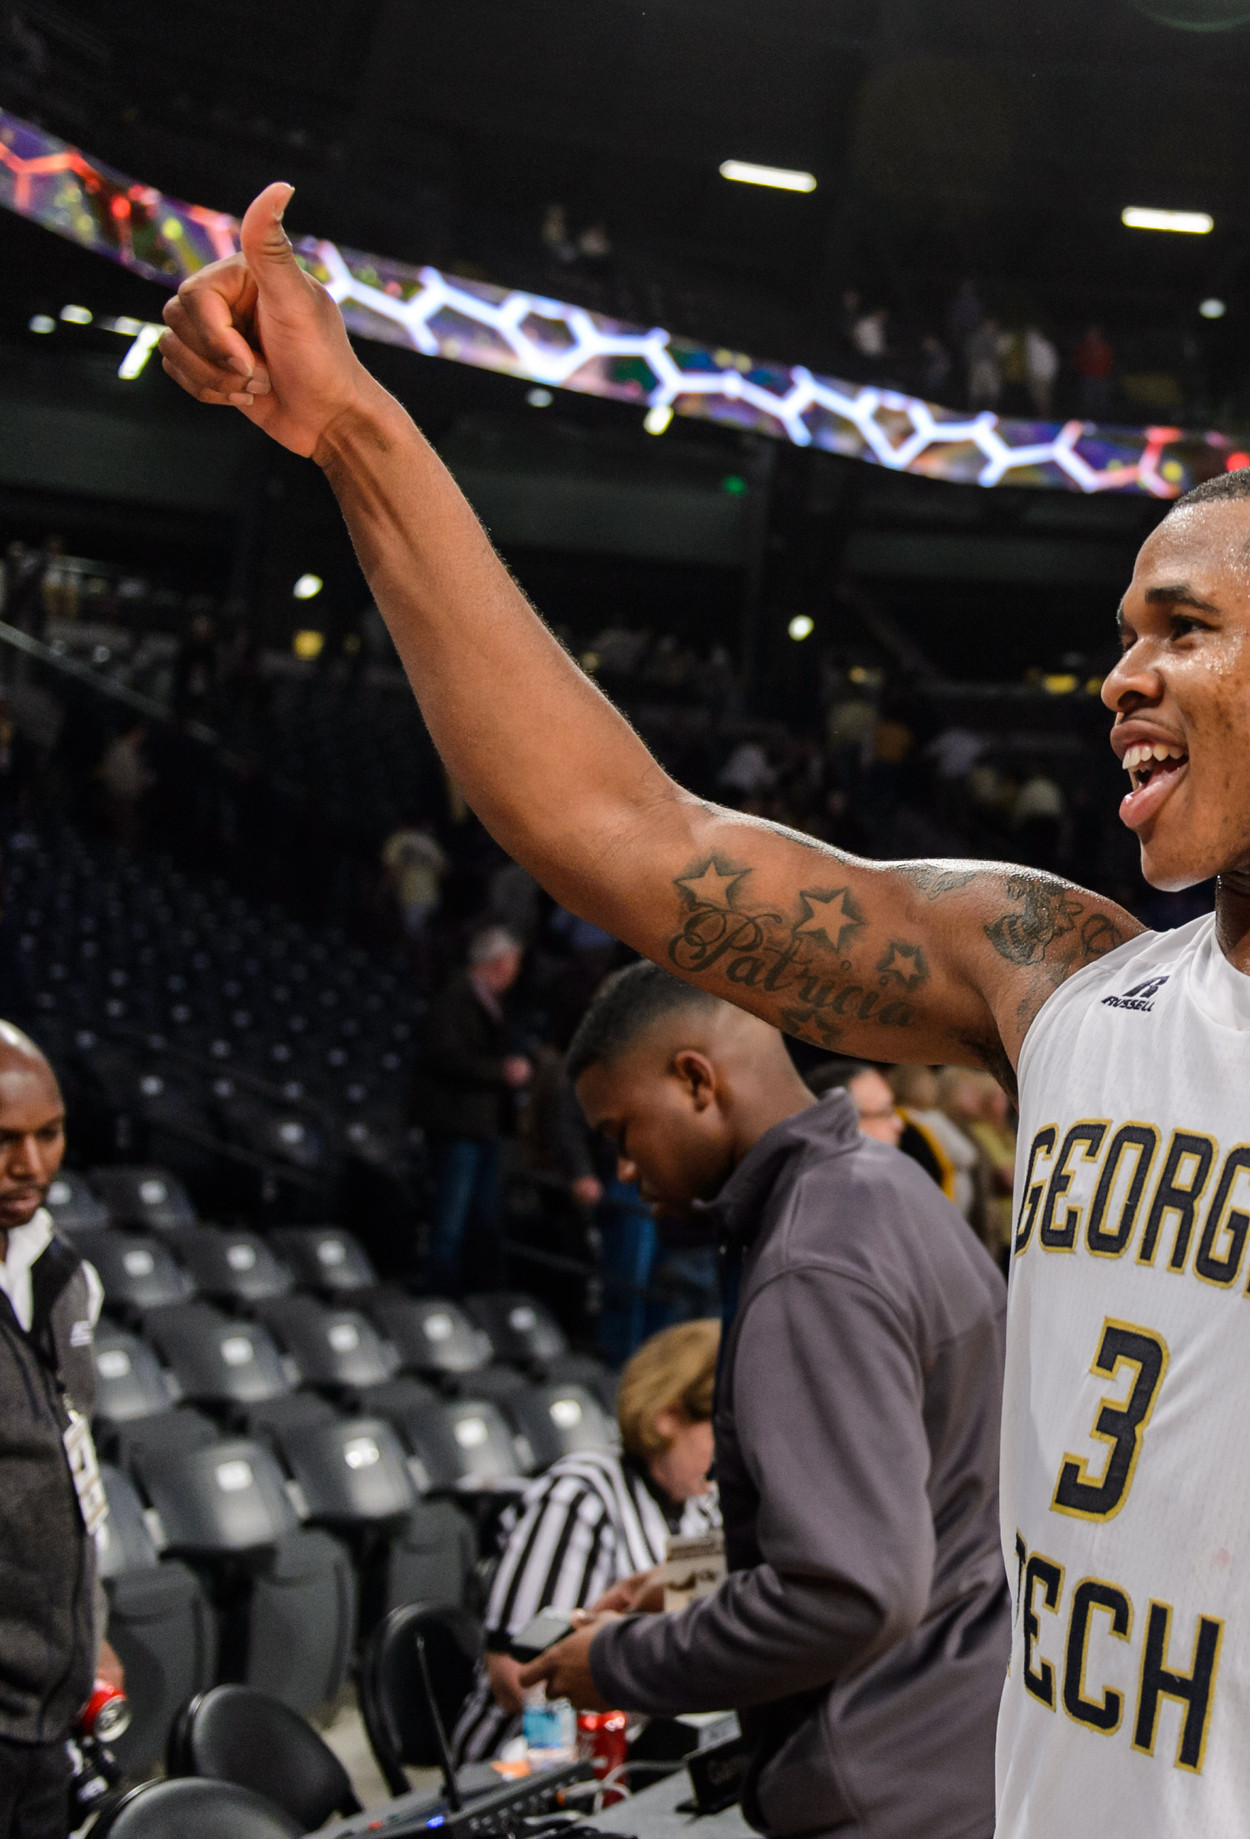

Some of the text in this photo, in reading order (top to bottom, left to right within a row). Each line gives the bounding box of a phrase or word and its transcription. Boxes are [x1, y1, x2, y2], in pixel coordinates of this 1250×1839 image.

[669, 904, 915, 1026] Patricia
[1101, 996, 1154, 1012] RUSSELL
[1049, 1317, 1170, 1523] 3
